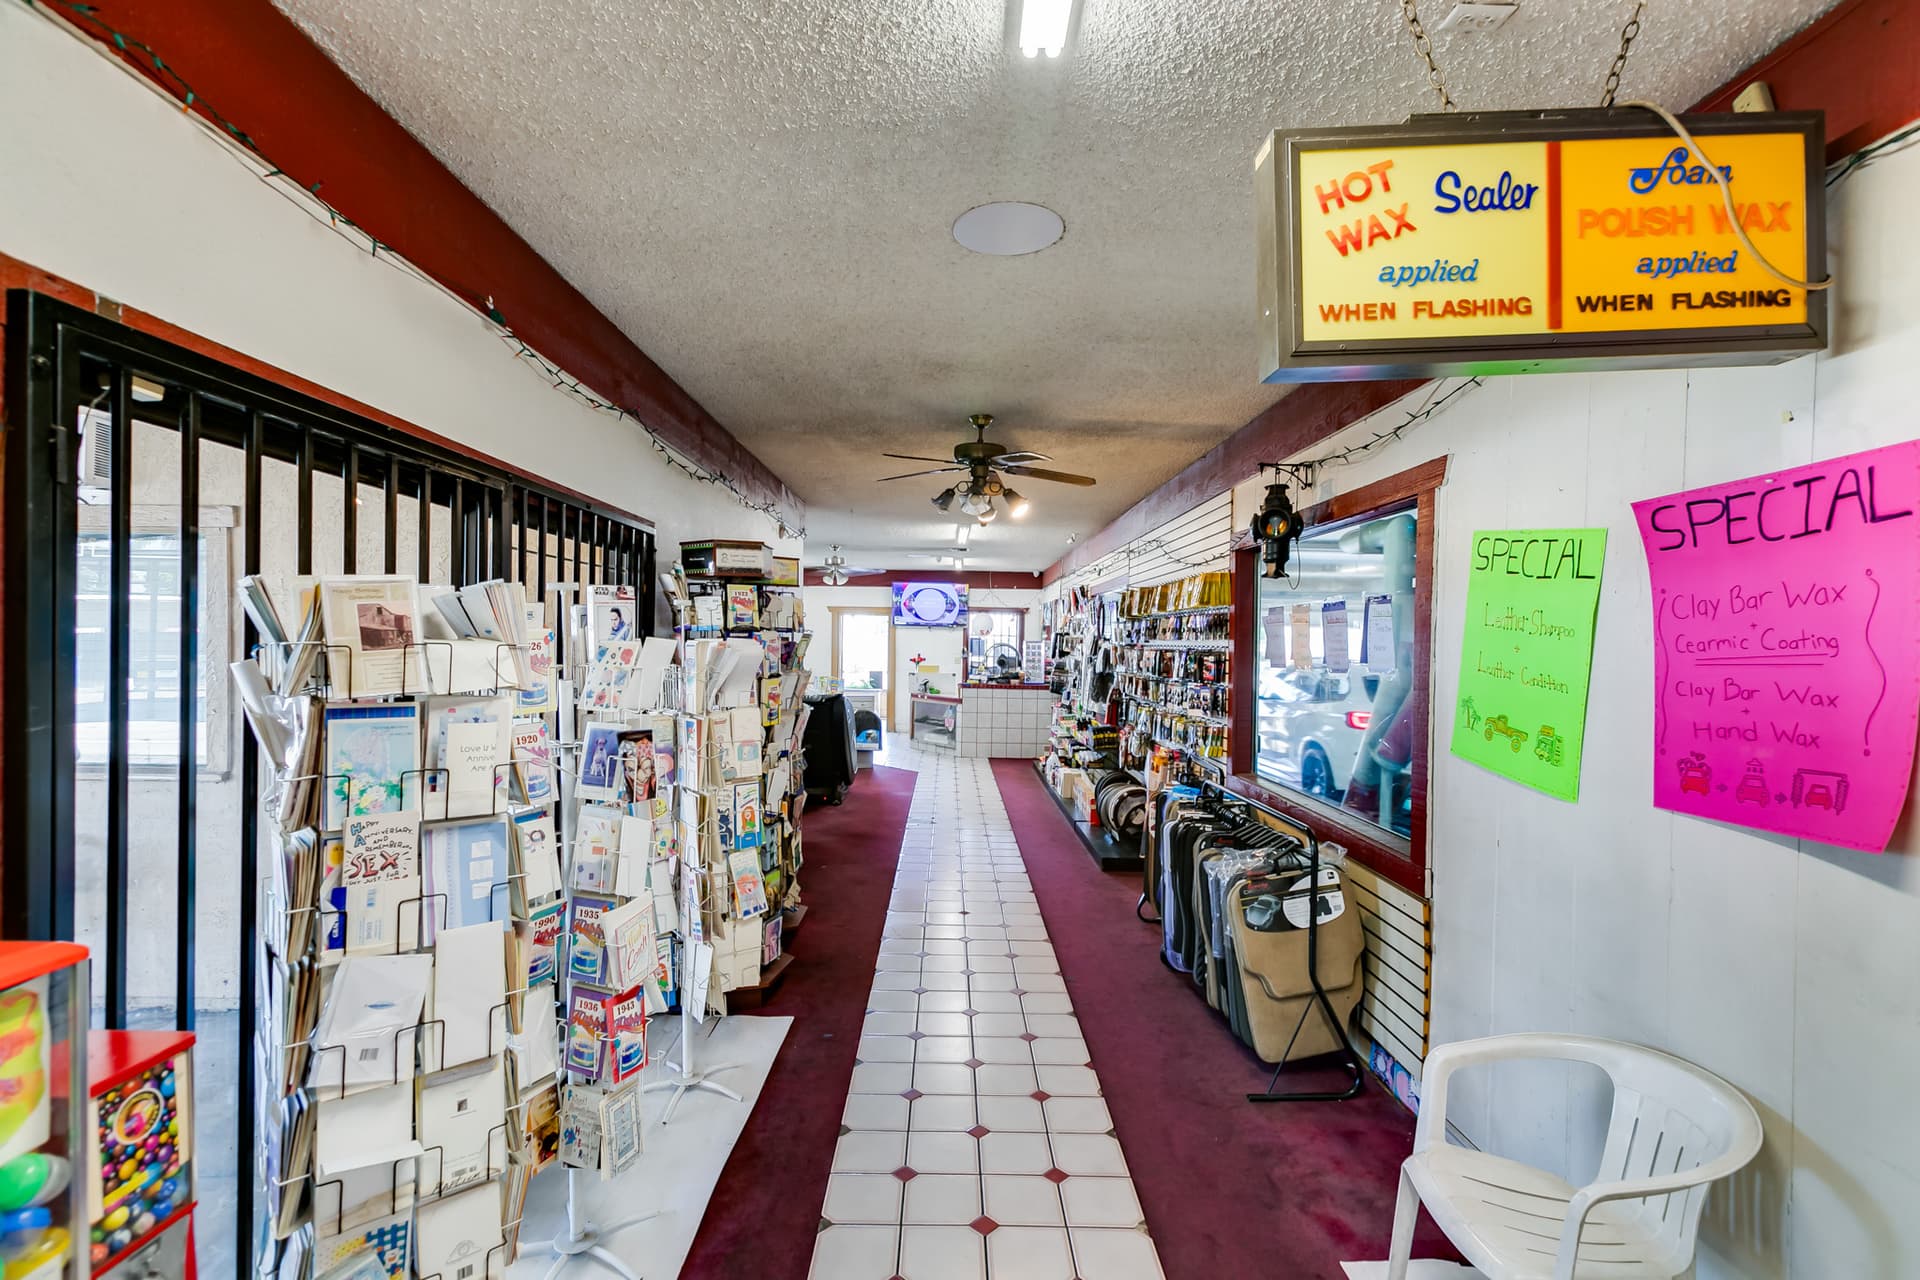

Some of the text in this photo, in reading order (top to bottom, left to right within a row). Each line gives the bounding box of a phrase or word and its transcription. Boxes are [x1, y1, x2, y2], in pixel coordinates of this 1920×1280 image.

[1315, 159, 1394, 214] HOT
[1434, 169, 1539, 214] Sealer
[1326, 202, 1417, 258] WAX
[1576, 201, 1792, 239] POLISH WAX
[1378, 259, 1480, 287] applied
[1635, 251, 1739, 279] applied
[1319, 296, 1533, 322] WHEN FLASHING
[1576, 289, 1792, 314] WHEN FLASHING
[1652, 466, 1912, 552] SPECIAL
[1475, 536, 1596, 580] SPECIAL
[1671, 580, 1847, 623] Clay Bar Wax
[1675, 627, 1839, 658] Cearmic Coating
[1675, 677, 1839, 708] Clay Bar Wax
[516, 735, 538, 745] 1920
[1694, 722, 1821, 749] Hand Wax
[348, 850, 400, 879] SEX
[534, 915, 556, 930] 1990
[579, 909, 599, 919] 1935
[579, 999, 599, 1012] 1936
